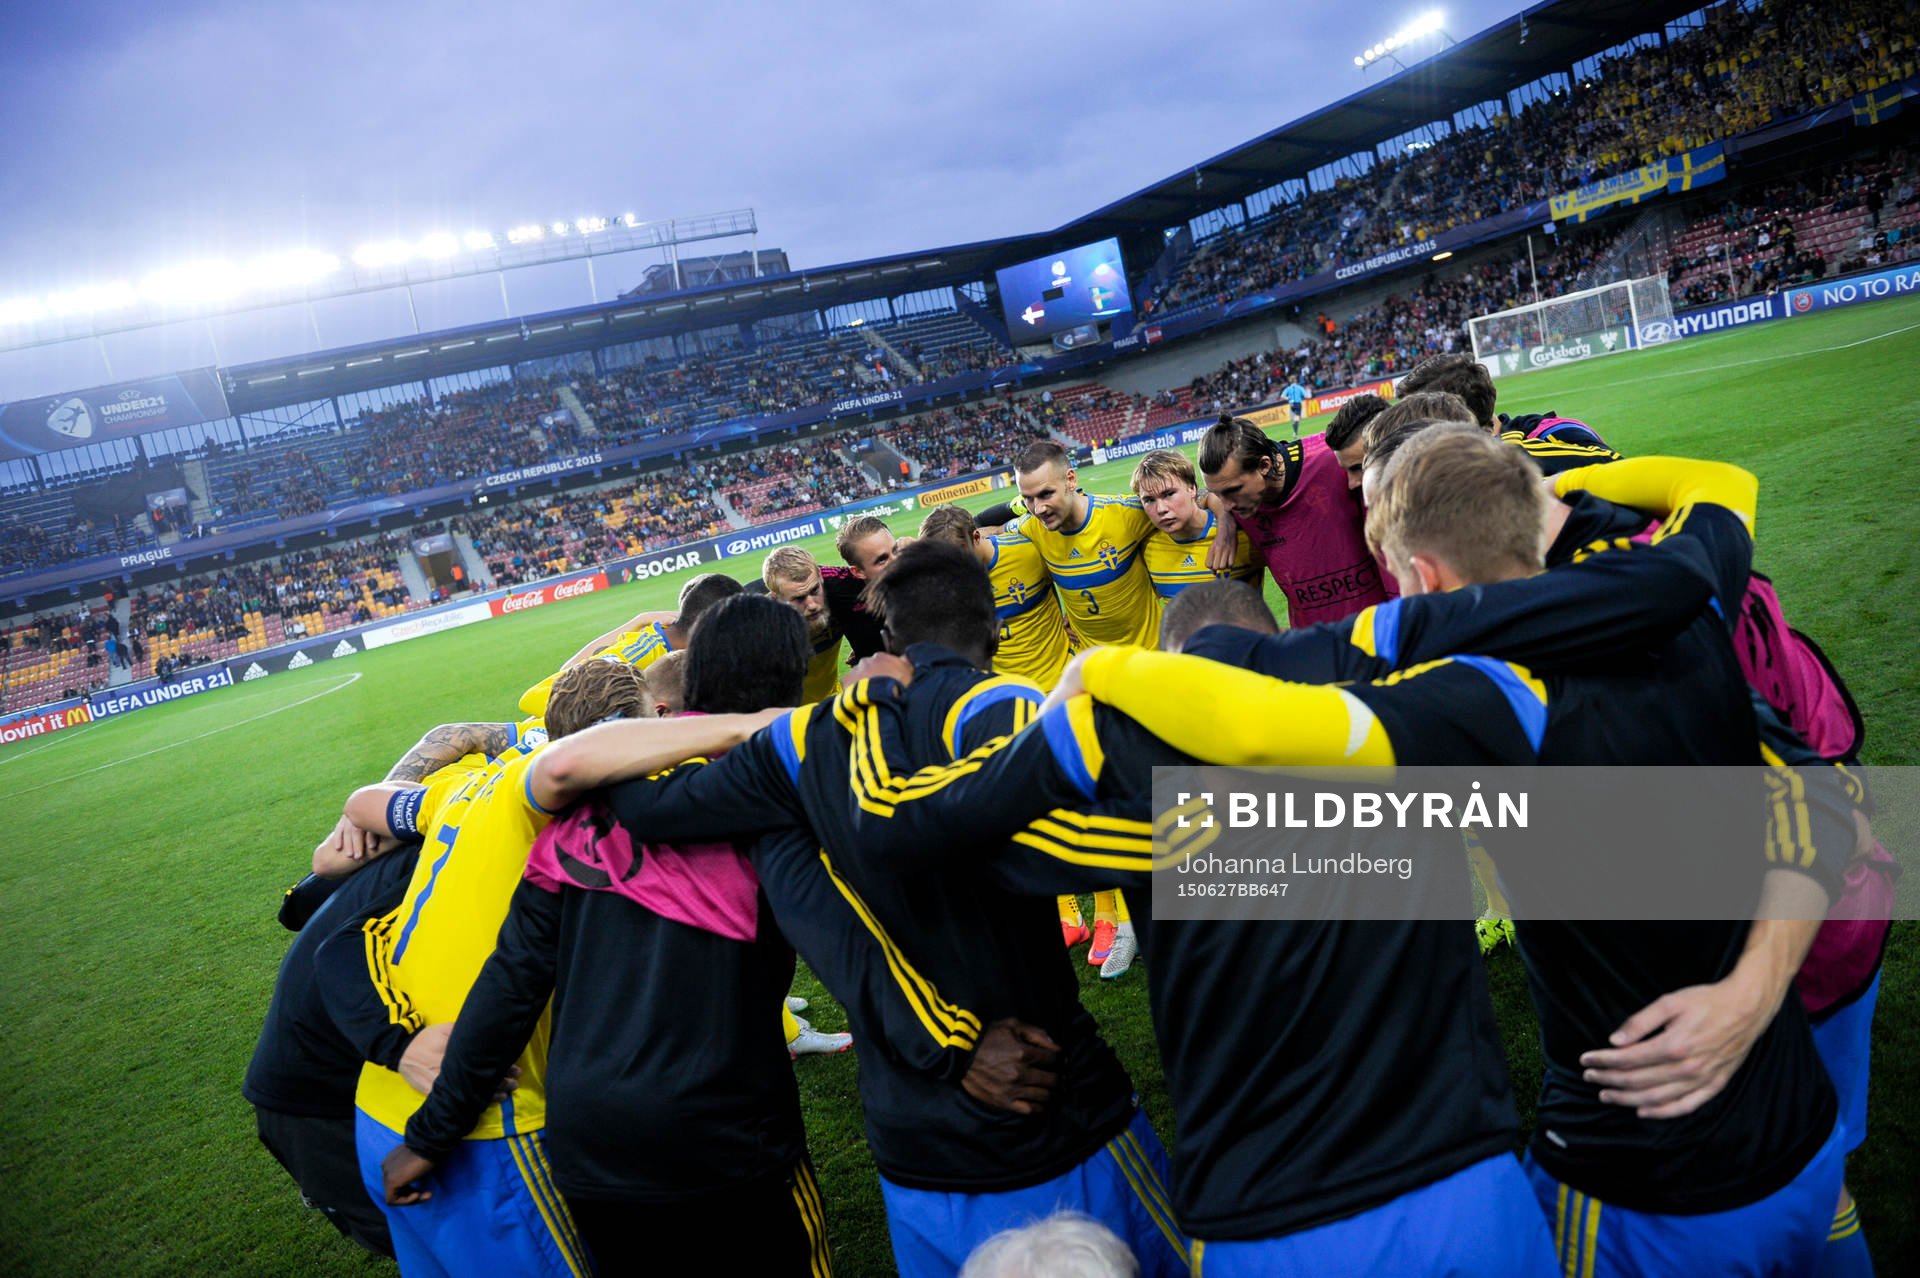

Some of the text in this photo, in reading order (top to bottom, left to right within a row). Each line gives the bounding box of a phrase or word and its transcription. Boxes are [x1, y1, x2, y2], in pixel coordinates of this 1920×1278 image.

[1335, 239, 1437, 280] CZECH REPUBLIC 2015
[1823, 284, 1857, 306] NO
[1859, 278, 1890, 298] TO
[1673, 299, 1773, 337] HYUNDAI
[1529, 343, 1591, 367] Carlsberg
[100, 395, 165, 416] UNDER21
[836, 390, 904, 411] UEFA UNDER-21
[1105, 436, 1167, 460] UEFA UNDER 21
[486, 454, 602, 486] CZECH REPUBLIC 2015
[921, 481, 979, 506] Continental
[750, 523, 816, 549] HYUNDAI
[120, 547, 172, 567] PRAGUE
[635, 551, 702, 580] SOCAR
[554, 577, 594, 600] Coca-Cola
[502, 590, 544, 613] Coca-Cola
[1080, 589, 1100, 615] 3
[92, 672, 229, 718] UEFA UNDER 21
[49, 714, 65, 730] it
[391, 824, 460, 966] 7
